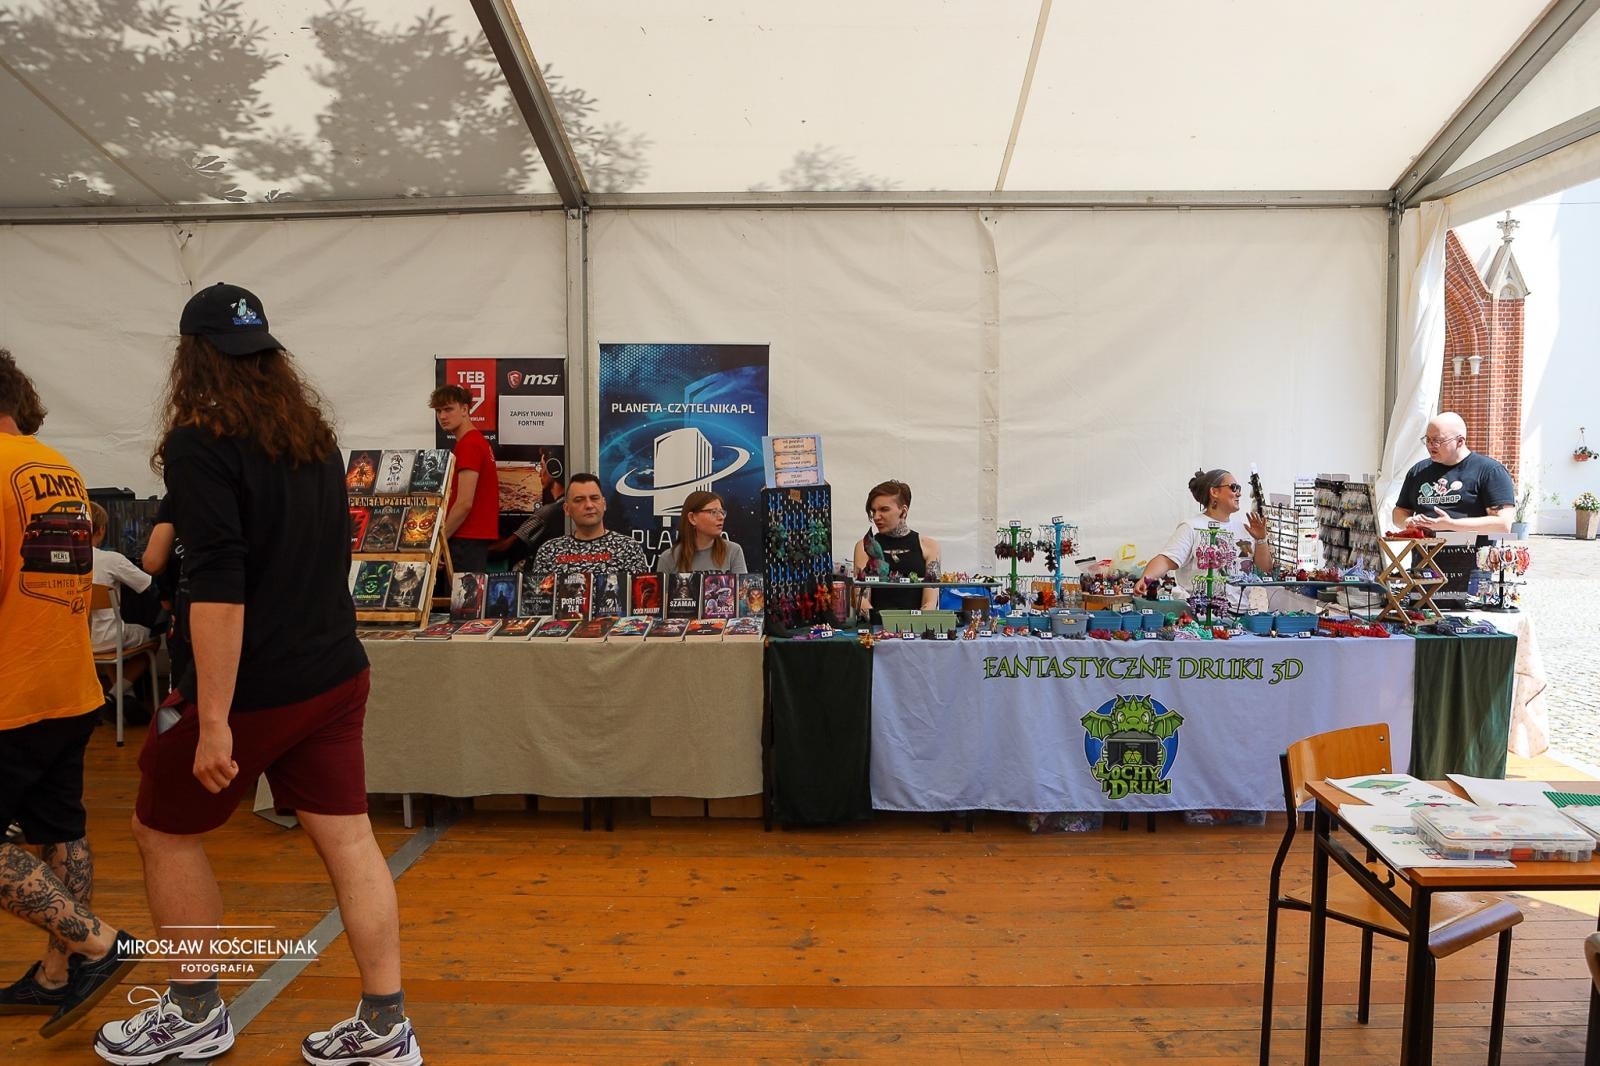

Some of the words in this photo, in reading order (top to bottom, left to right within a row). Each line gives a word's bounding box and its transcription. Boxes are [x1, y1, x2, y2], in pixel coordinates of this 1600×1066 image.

[457, 371, 485, 383] TEB
[523, 373, 558, 385] msi
[611, 402, 755, 414] PLANETA-CZYTELNIKA.PL
[348, 496, 381, 507] PLANETA
[383, 496, 428, 507] CZYTELNIKA
[1440, 494, 1461, 504] SHOP
[561, 598, 587, 609] PORTRET
[669, 600, 697, 608] SZAMAN
[983, 654, 1172, 681] FANTASTYCZNE
[1179, 656, 1264, 680] DRUKI
[1270, 656, 1304, 685] 3D
[1093, 761, 1162, 781] LOCHY
[1108, 778, 1172, 799] DRUKI
